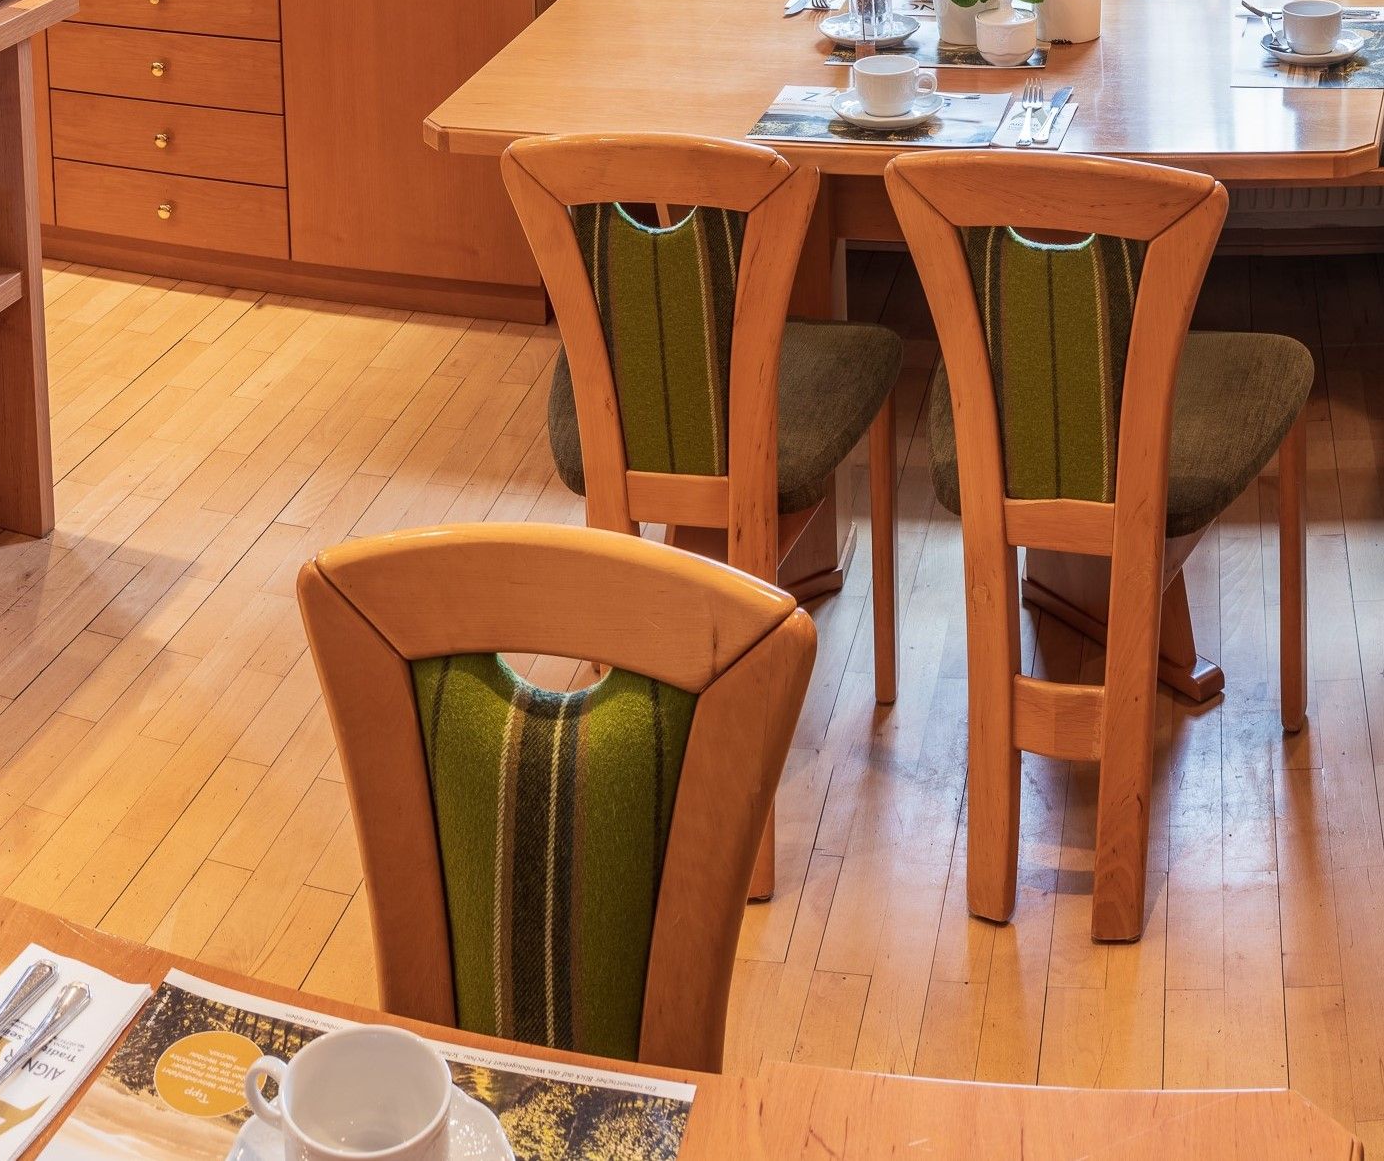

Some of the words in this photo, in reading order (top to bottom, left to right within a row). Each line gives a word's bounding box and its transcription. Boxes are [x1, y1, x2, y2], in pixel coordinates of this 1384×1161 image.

[3, 1048, 66, 1082] AIGNR
[495, 1057, 547, 1075] Weinbaugebiet
[549, 1068, 560, 1076] das
[561, 1067, 575, 1080] auf
[576, 1069, 594, 1082] Blick
[596, 1075, 644, 1090] romantischer
[645, 1084, 658, 1093] Ein
[184, 1087, 209, 1105] Tipp
